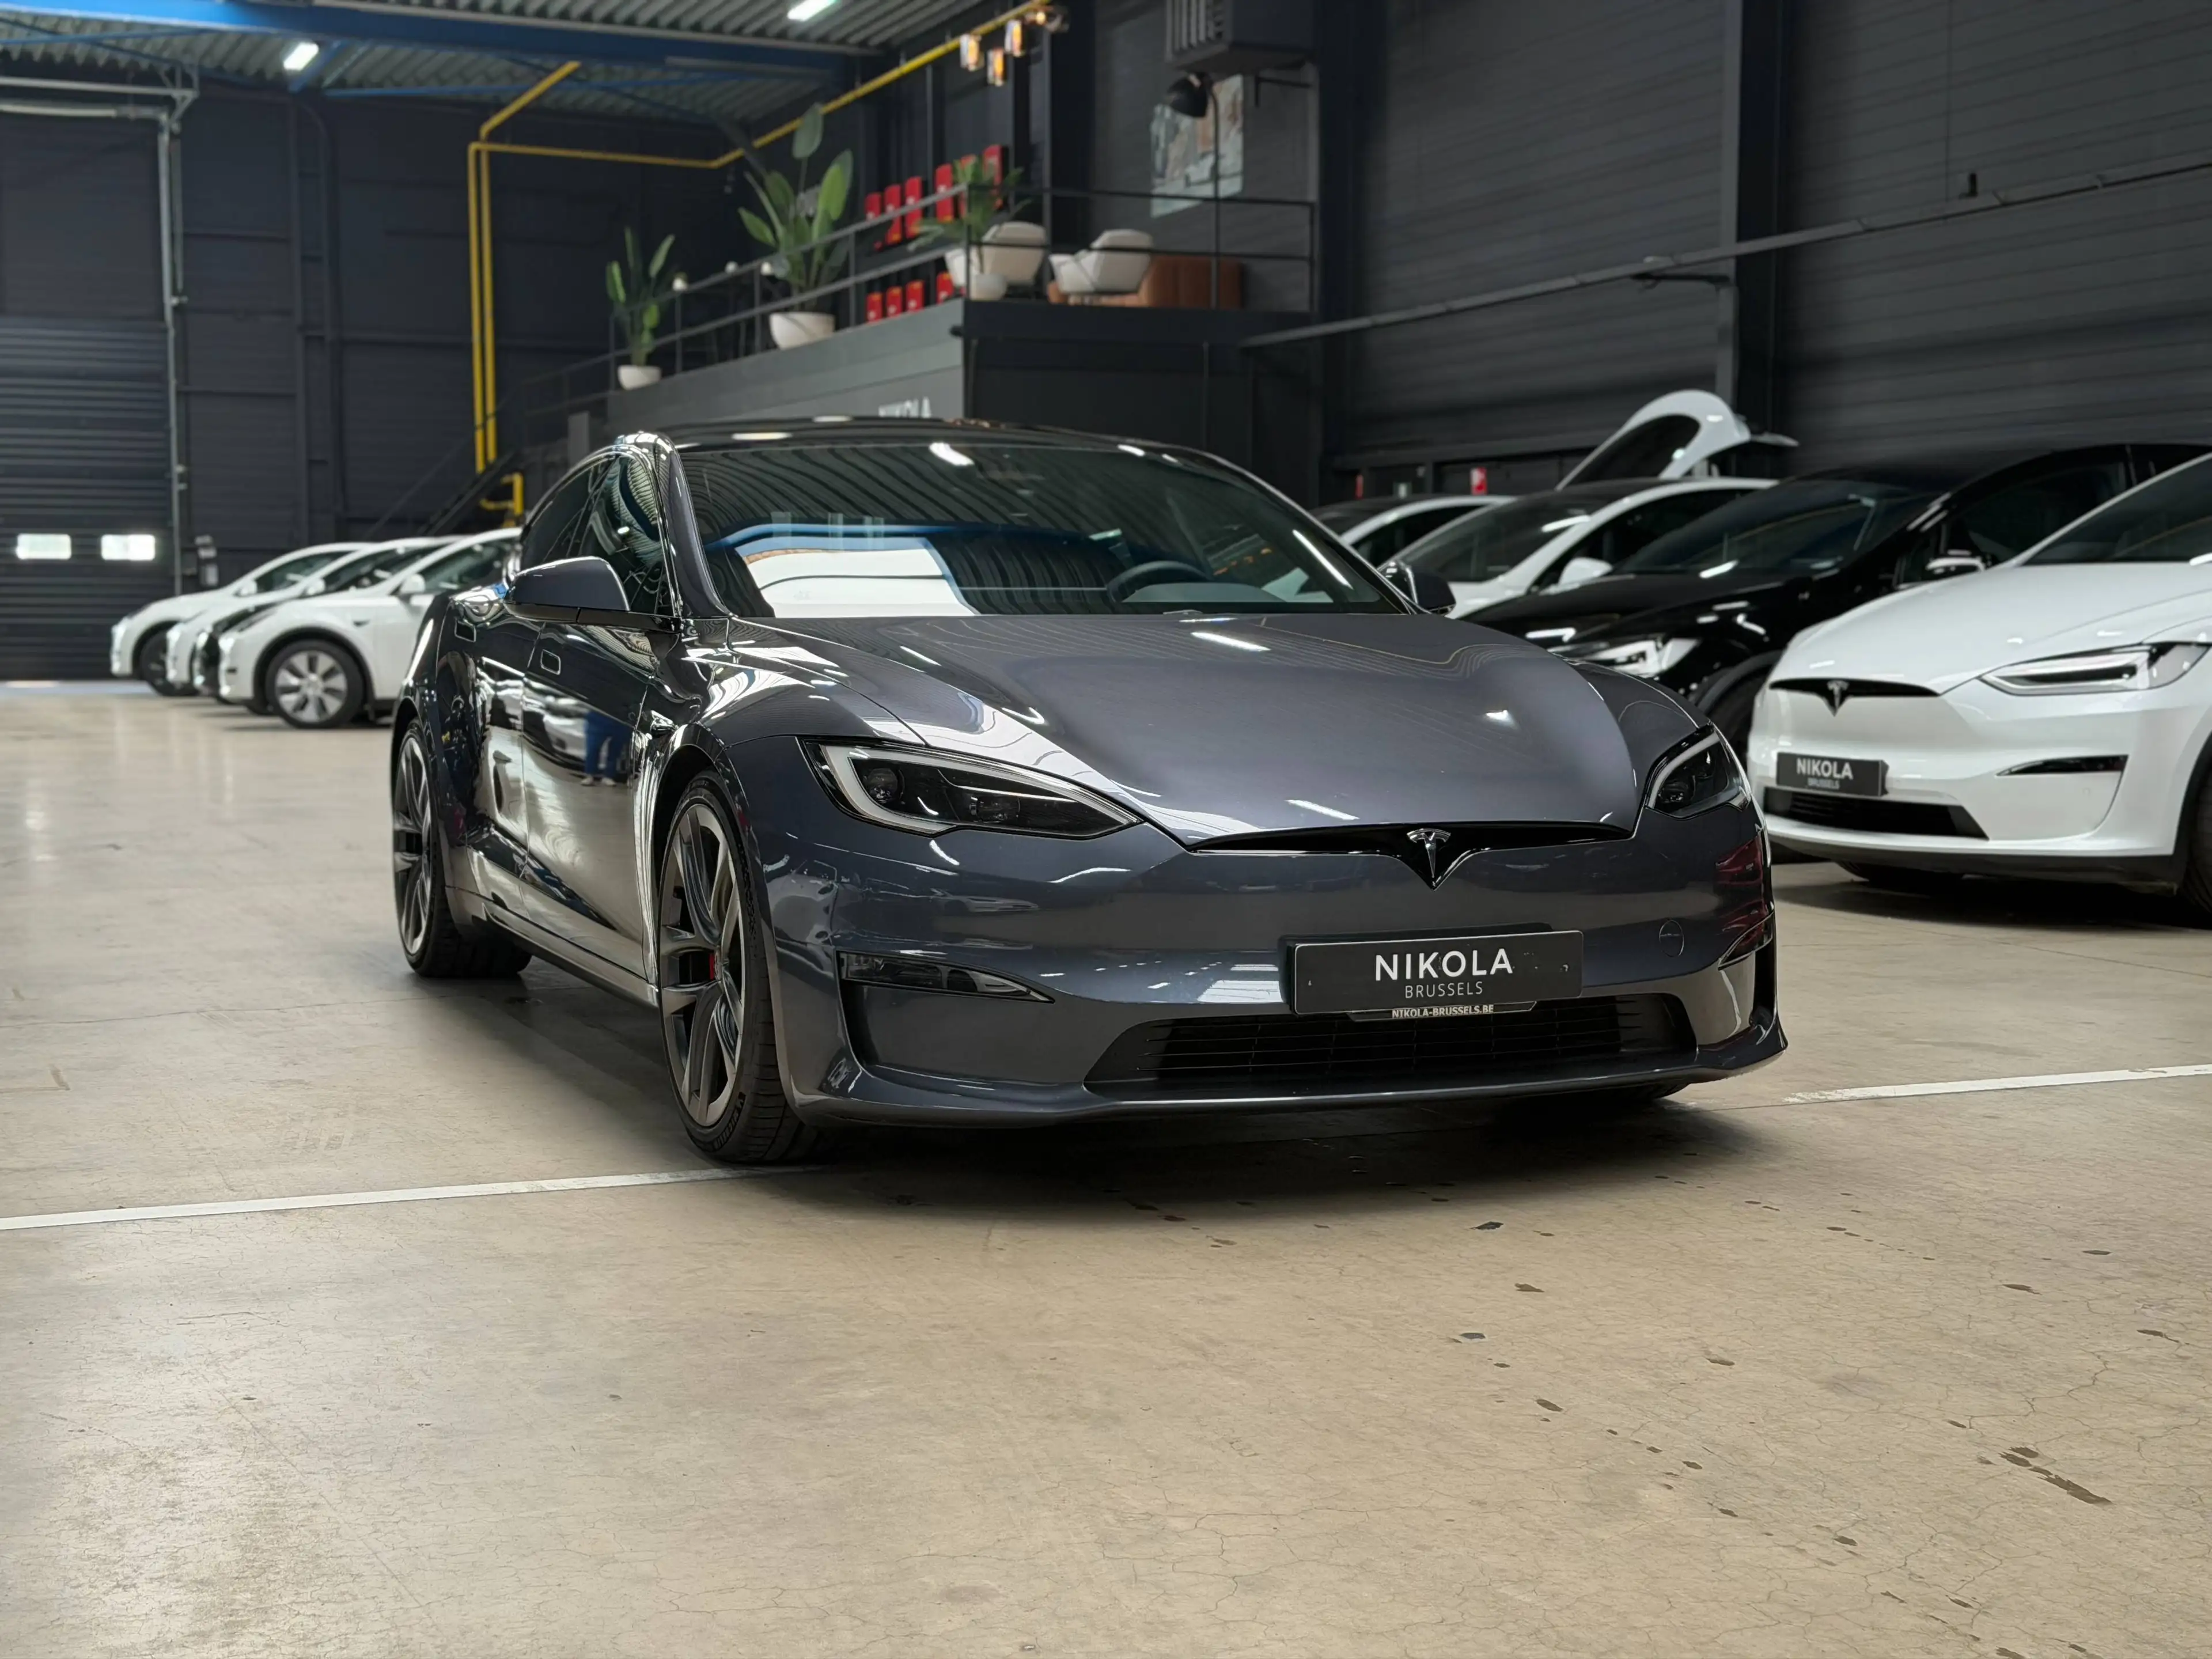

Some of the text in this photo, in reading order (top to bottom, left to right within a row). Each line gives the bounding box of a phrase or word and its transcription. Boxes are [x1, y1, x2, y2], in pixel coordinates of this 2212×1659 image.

[1797, 757, 1854, 780] NIKOLA
[1375, 948, 1513, 981] NIKOLA
[1405, 981, 1483, 998] BRUSSELS
[1392, 1004, 1494, 1019] NIKOLA-BRUSSELS.BE
